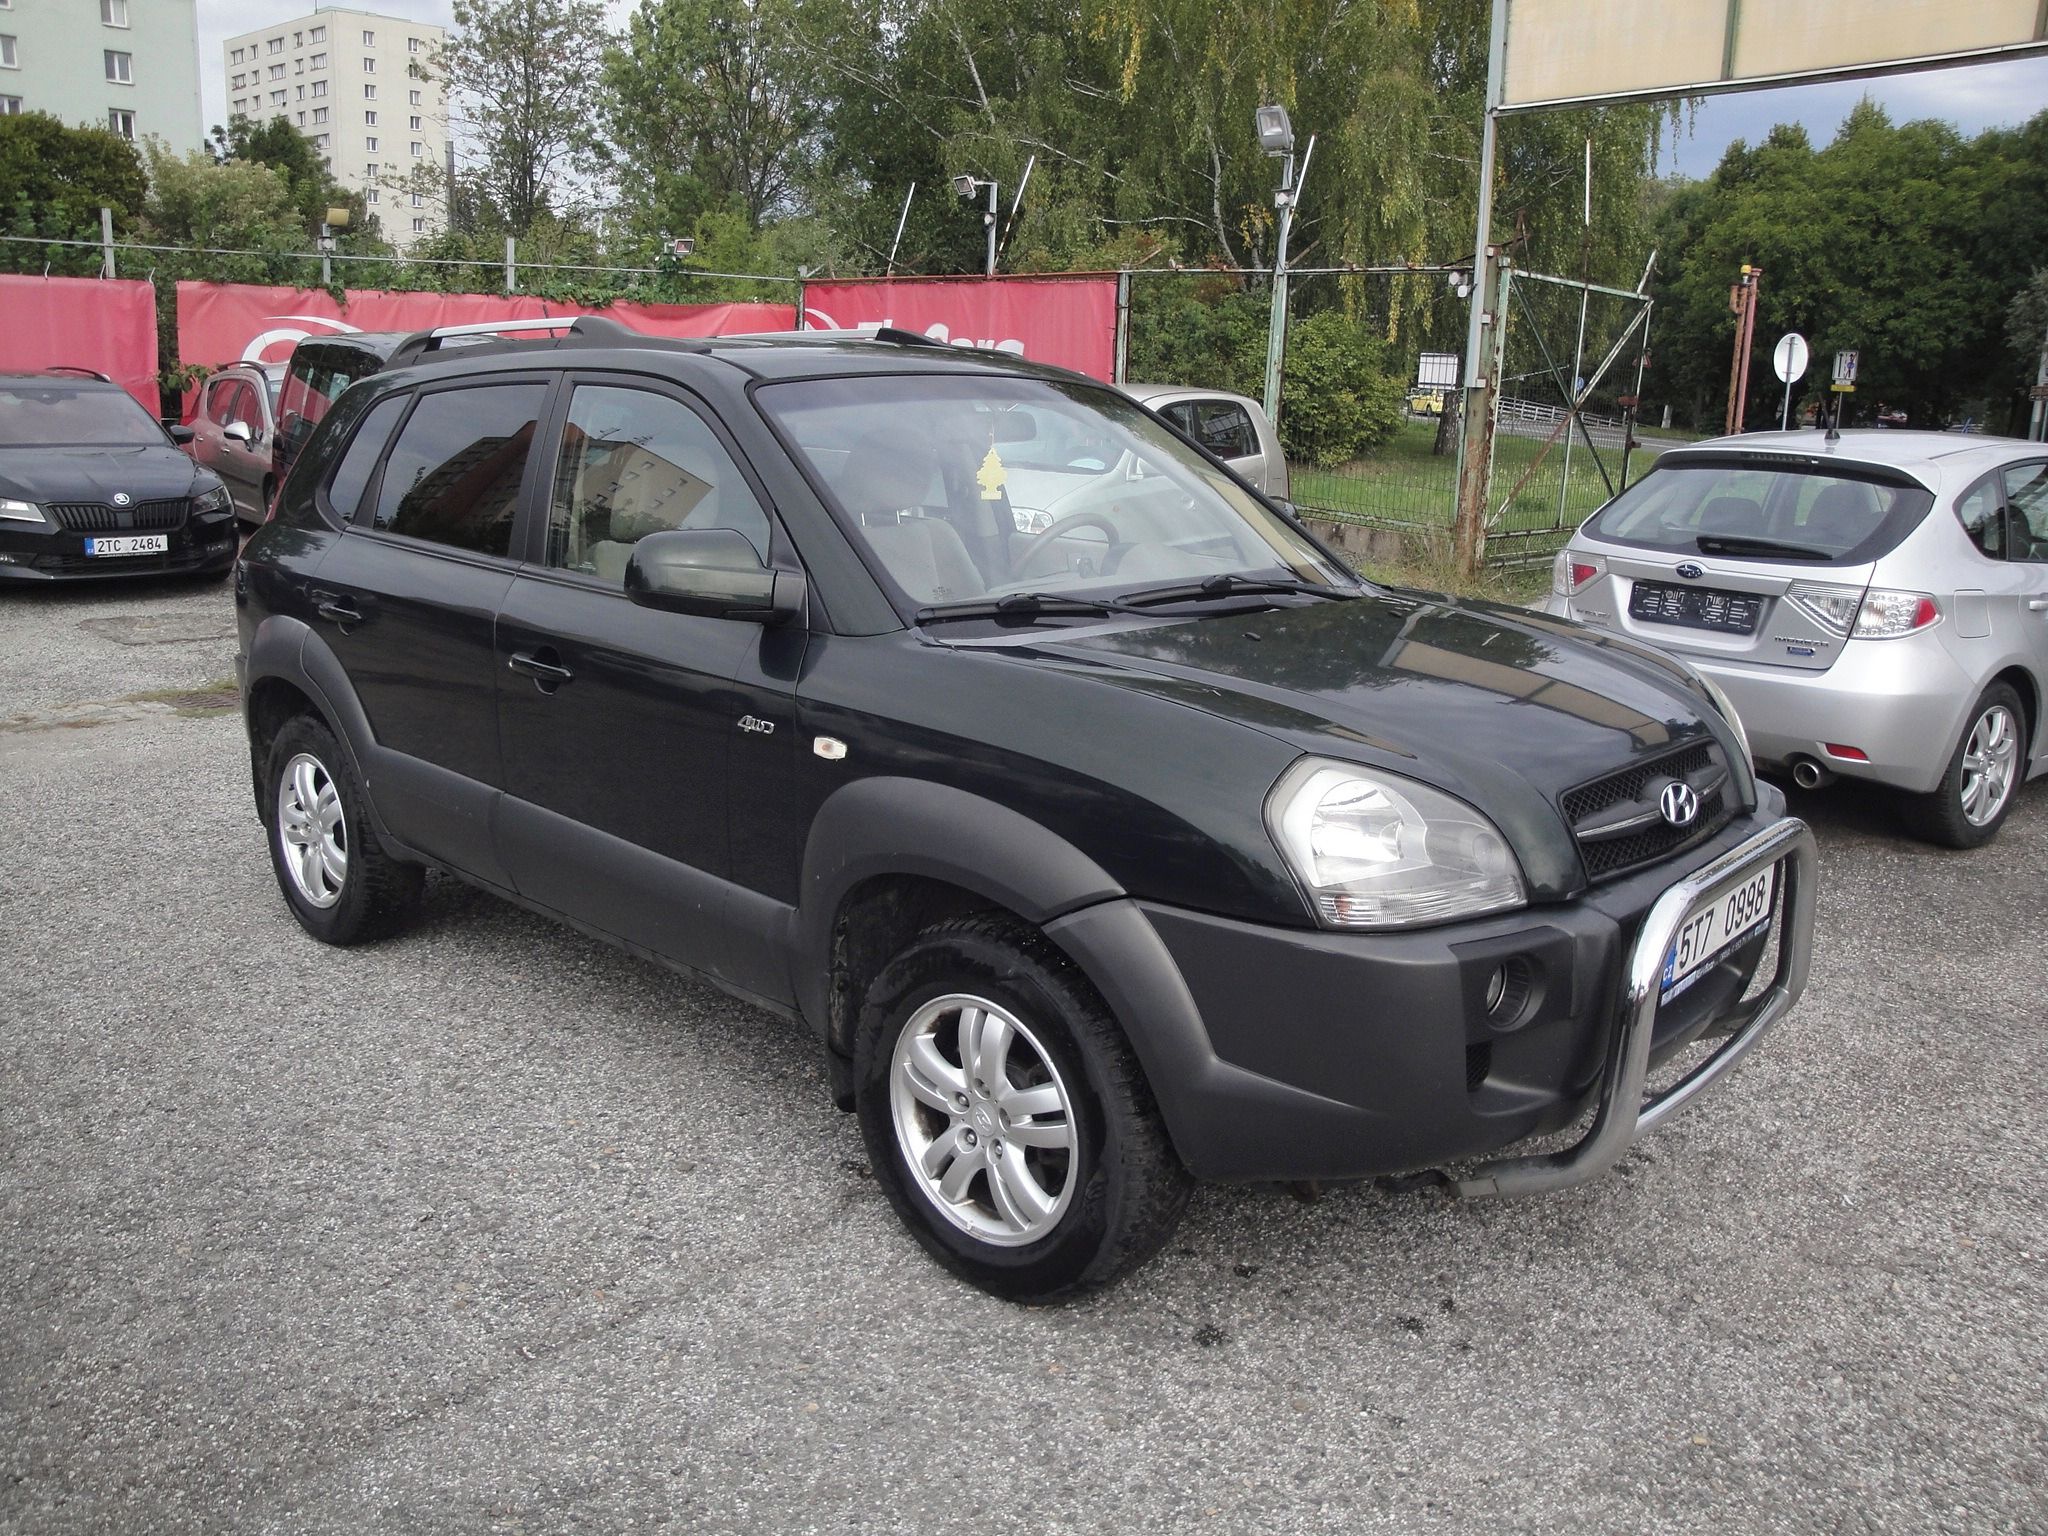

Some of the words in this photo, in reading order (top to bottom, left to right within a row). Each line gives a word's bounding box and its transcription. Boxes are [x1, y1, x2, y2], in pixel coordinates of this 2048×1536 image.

[97, 540, 121, 552] 2TC
[131, 537, 162, 551] 2484
[1679, 906, 1716, 970] 5T7
[1724, 874, 1766, 937] 0998
[1662, 964, 1673, 981] CZ
